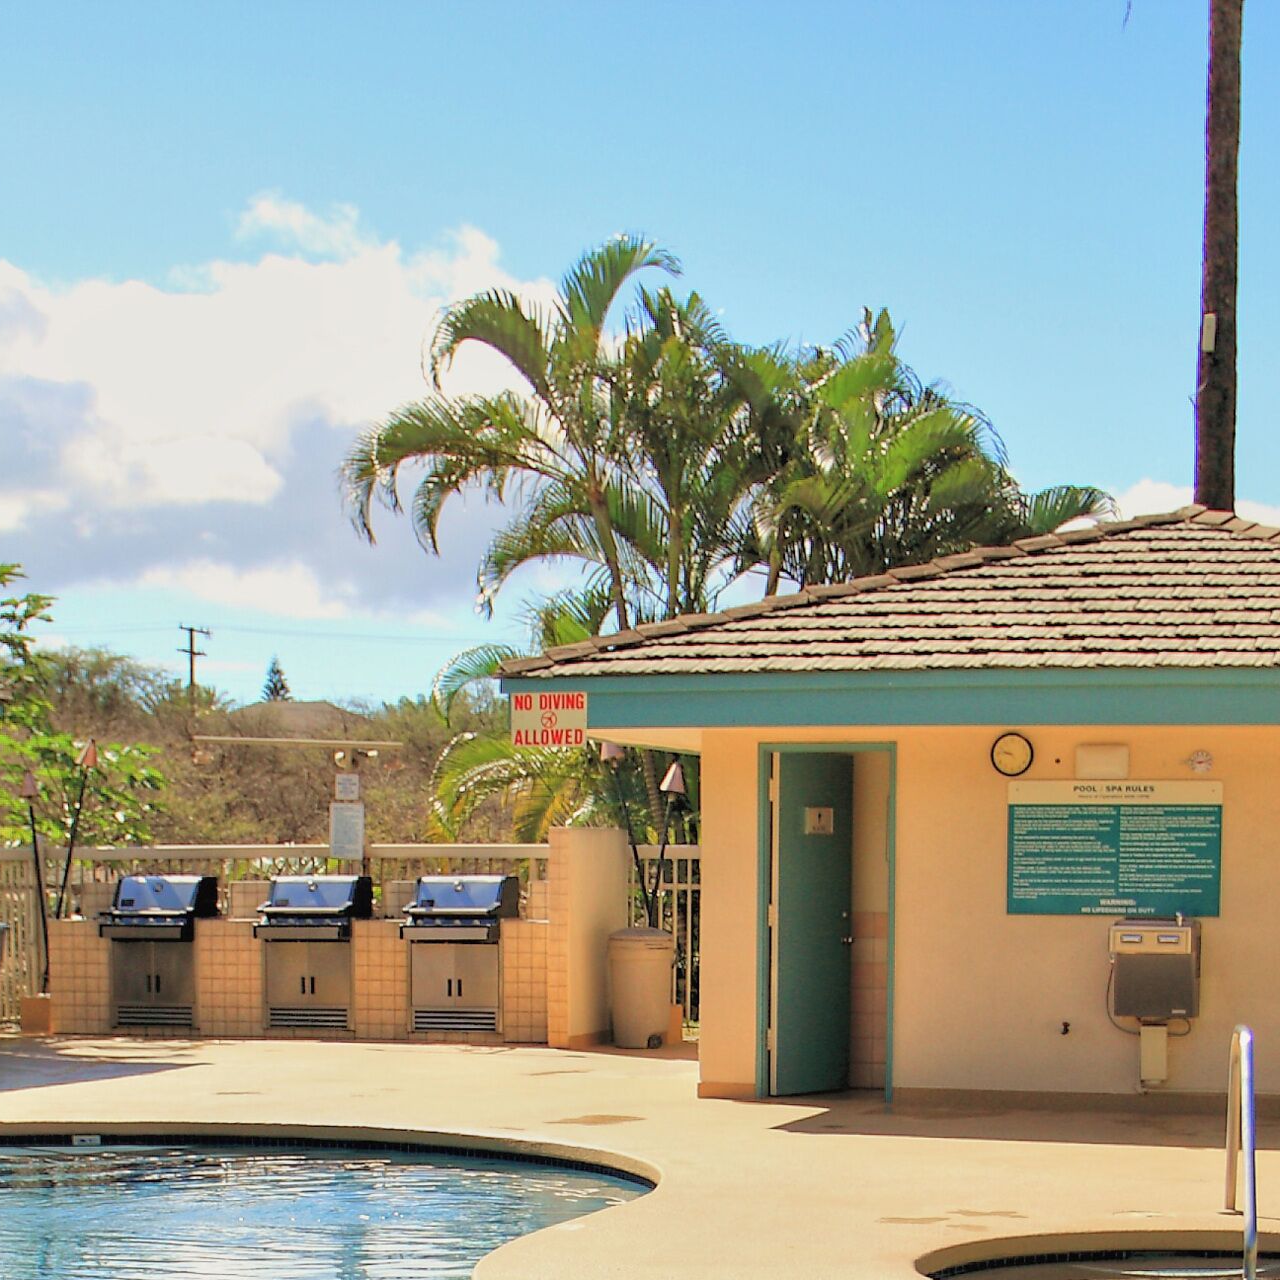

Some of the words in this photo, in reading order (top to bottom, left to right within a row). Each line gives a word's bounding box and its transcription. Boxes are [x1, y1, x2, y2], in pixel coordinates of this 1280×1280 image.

[514, 694, 533, 711] NO
[539, 693, 584, 710] DIVING
[514, 728, 583, 745] ALLOWED
[1138, 906, 1155, 914] DUTY
